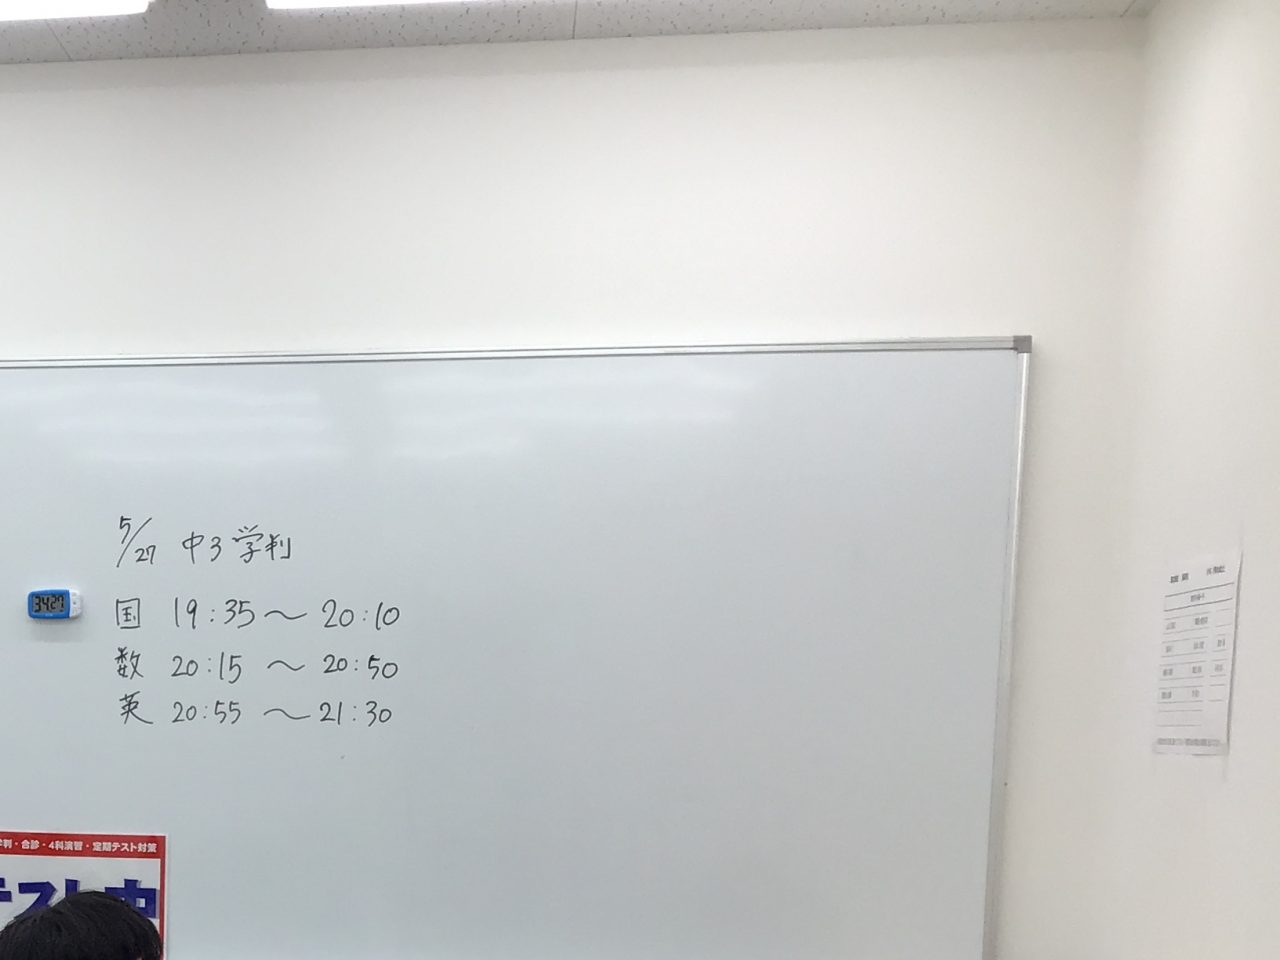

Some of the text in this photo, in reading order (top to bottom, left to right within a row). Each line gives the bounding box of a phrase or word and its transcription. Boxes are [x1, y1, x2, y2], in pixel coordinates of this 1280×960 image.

[115, 597, 142, 630] 国
[114, 646, 145, 681] 数
[118, 690, 154, 725] 英
